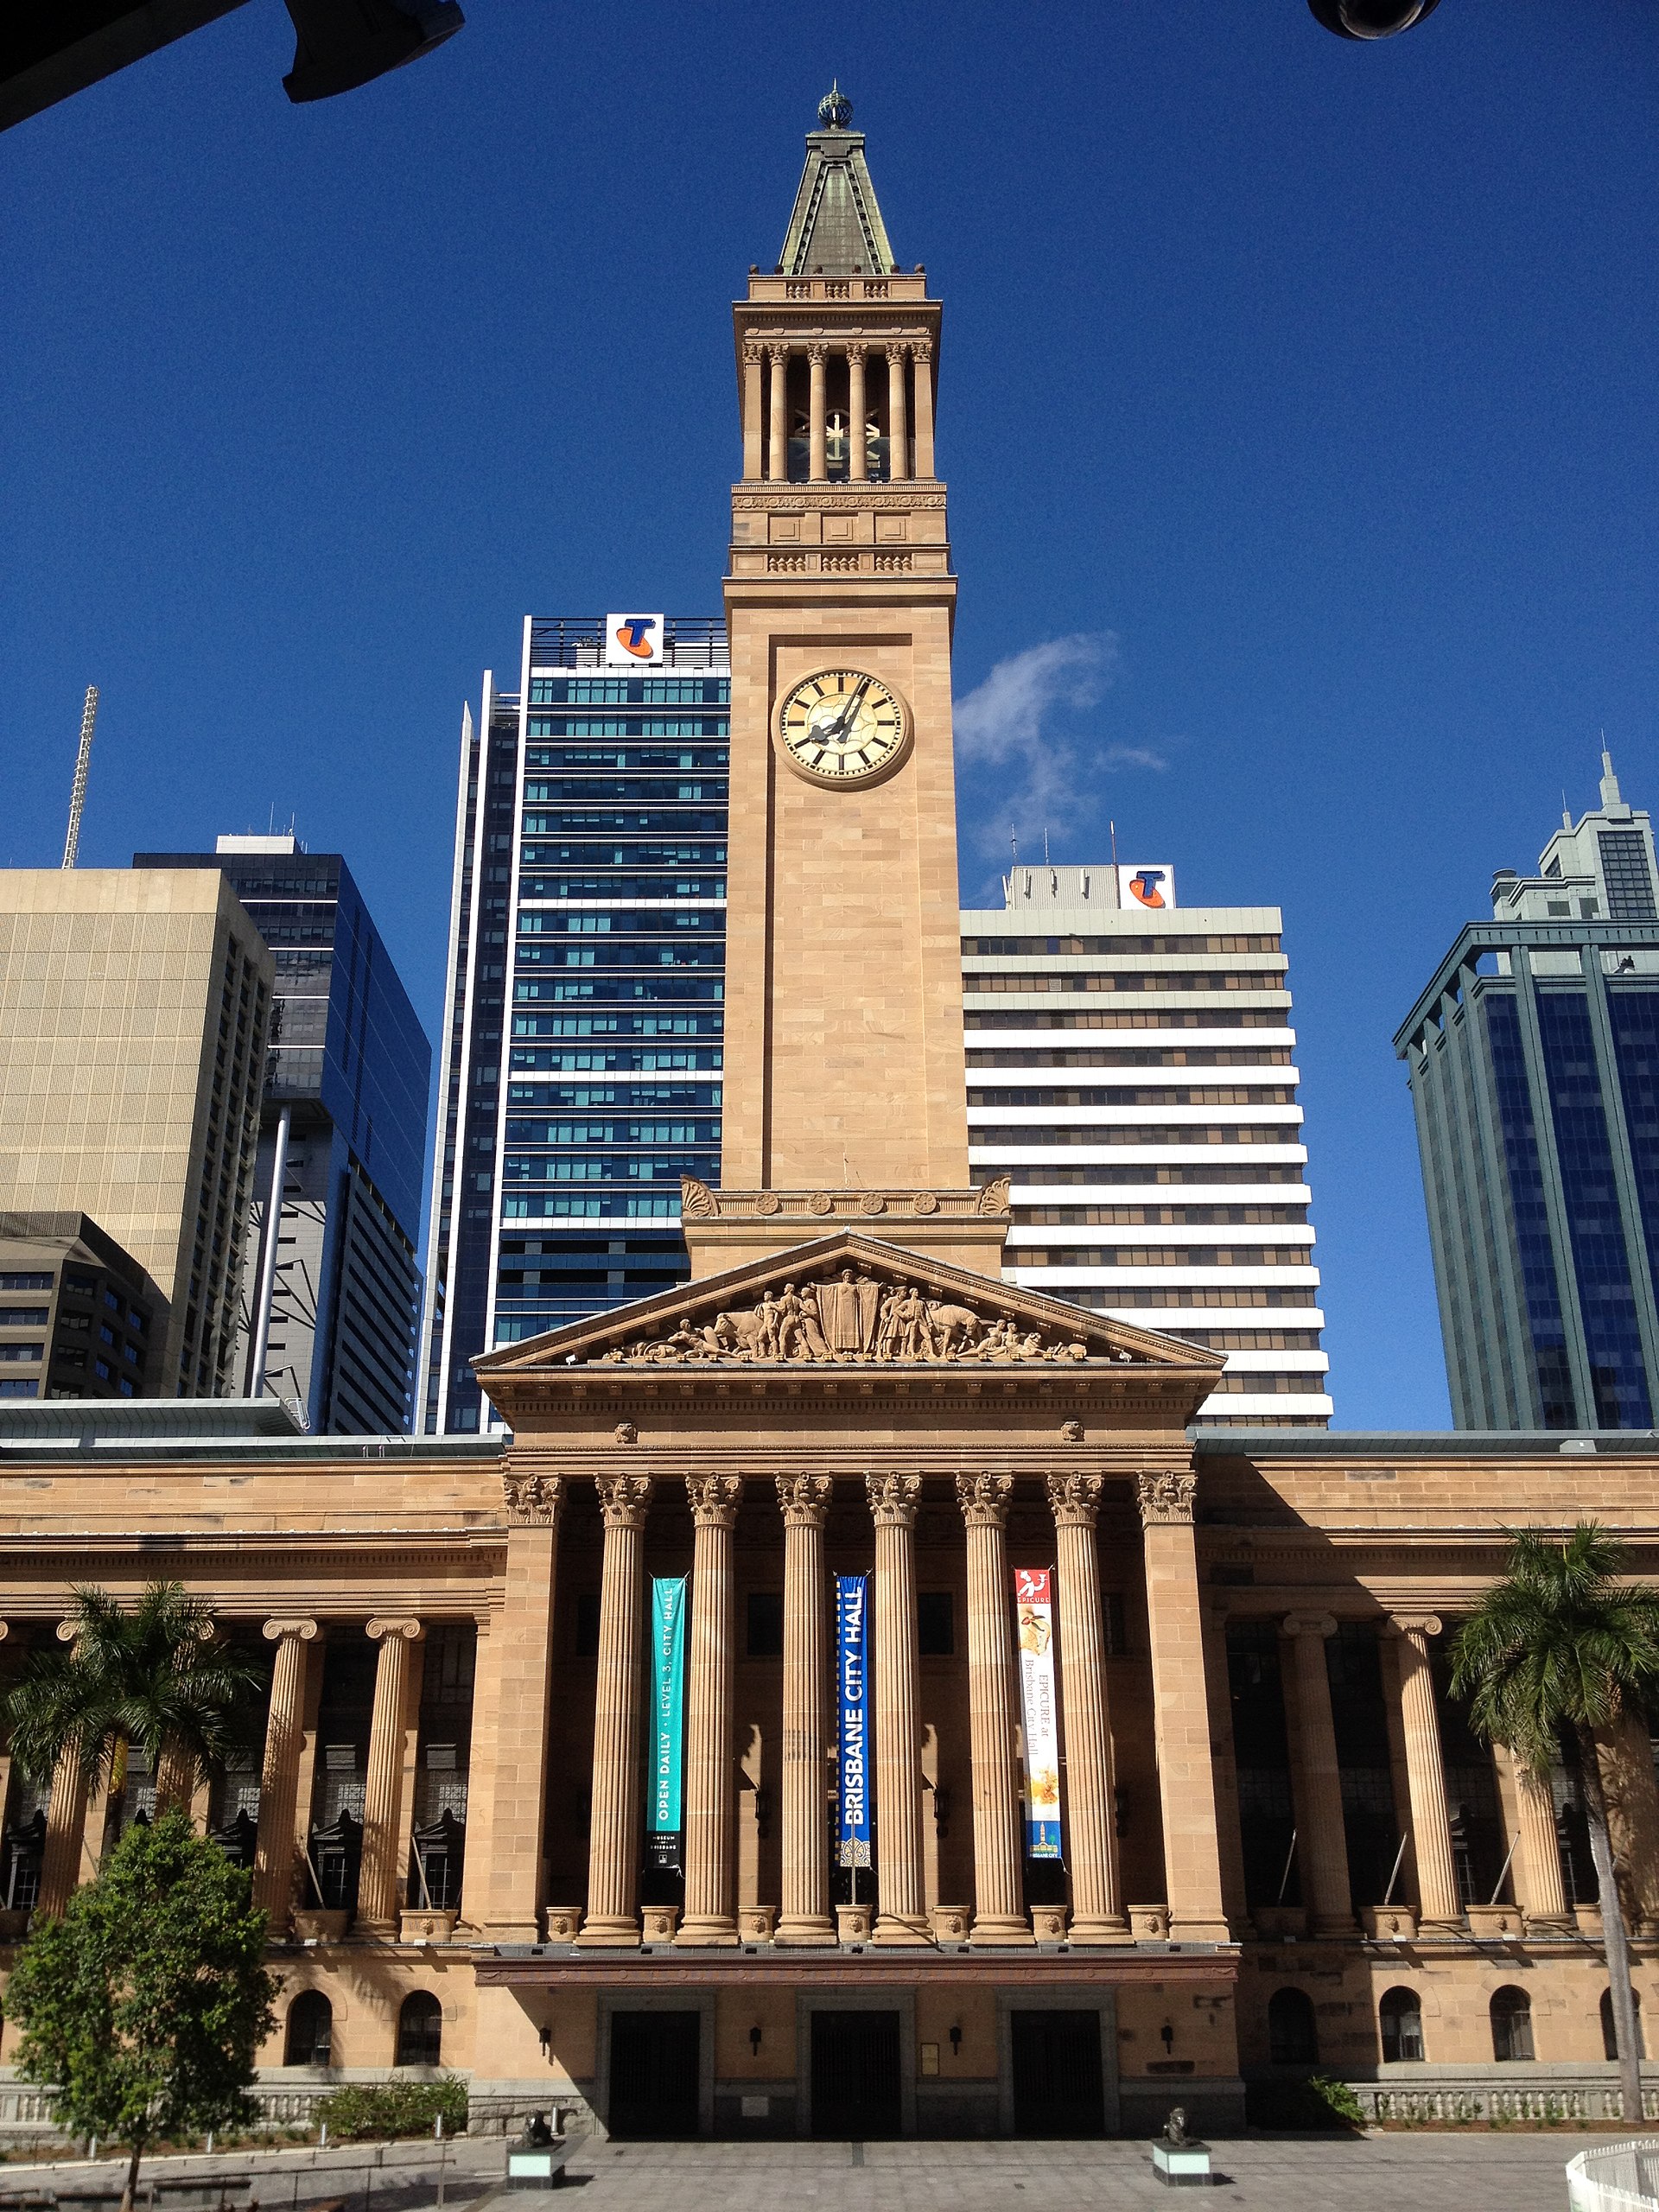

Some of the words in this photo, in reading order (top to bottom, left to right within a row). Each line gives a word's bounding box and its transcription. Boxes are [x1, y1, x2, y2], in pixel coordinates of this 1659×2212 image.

[625, 619, 656, 647] T
[1136, 871, 1166, 899] T
[663, 1587, 673, 1621] HALL
[844, 1586, 863, 1643] HALL
[663, 1624, 673, 1656] CITY
[662, 1662, 672, 1672] 3,
[844, 1649, 863, 1701] CITY
[1025, 1659, 1035, 1705] Brisbane
[661, 1677, 671, 1718] LEVEL
[1039, 1675, 1051, 1725] EPICURE
[1027, 1707, 1037, 1730] City
[1040, 1726, 1049, 1737] at
[659, 1732, 671, 1774] DAILY
[1028, 1732, 1039, 1755] Hall
[844, 1708, 864, 1825] BRISBANE
[658, 1780, 670, 1821] OPEN
